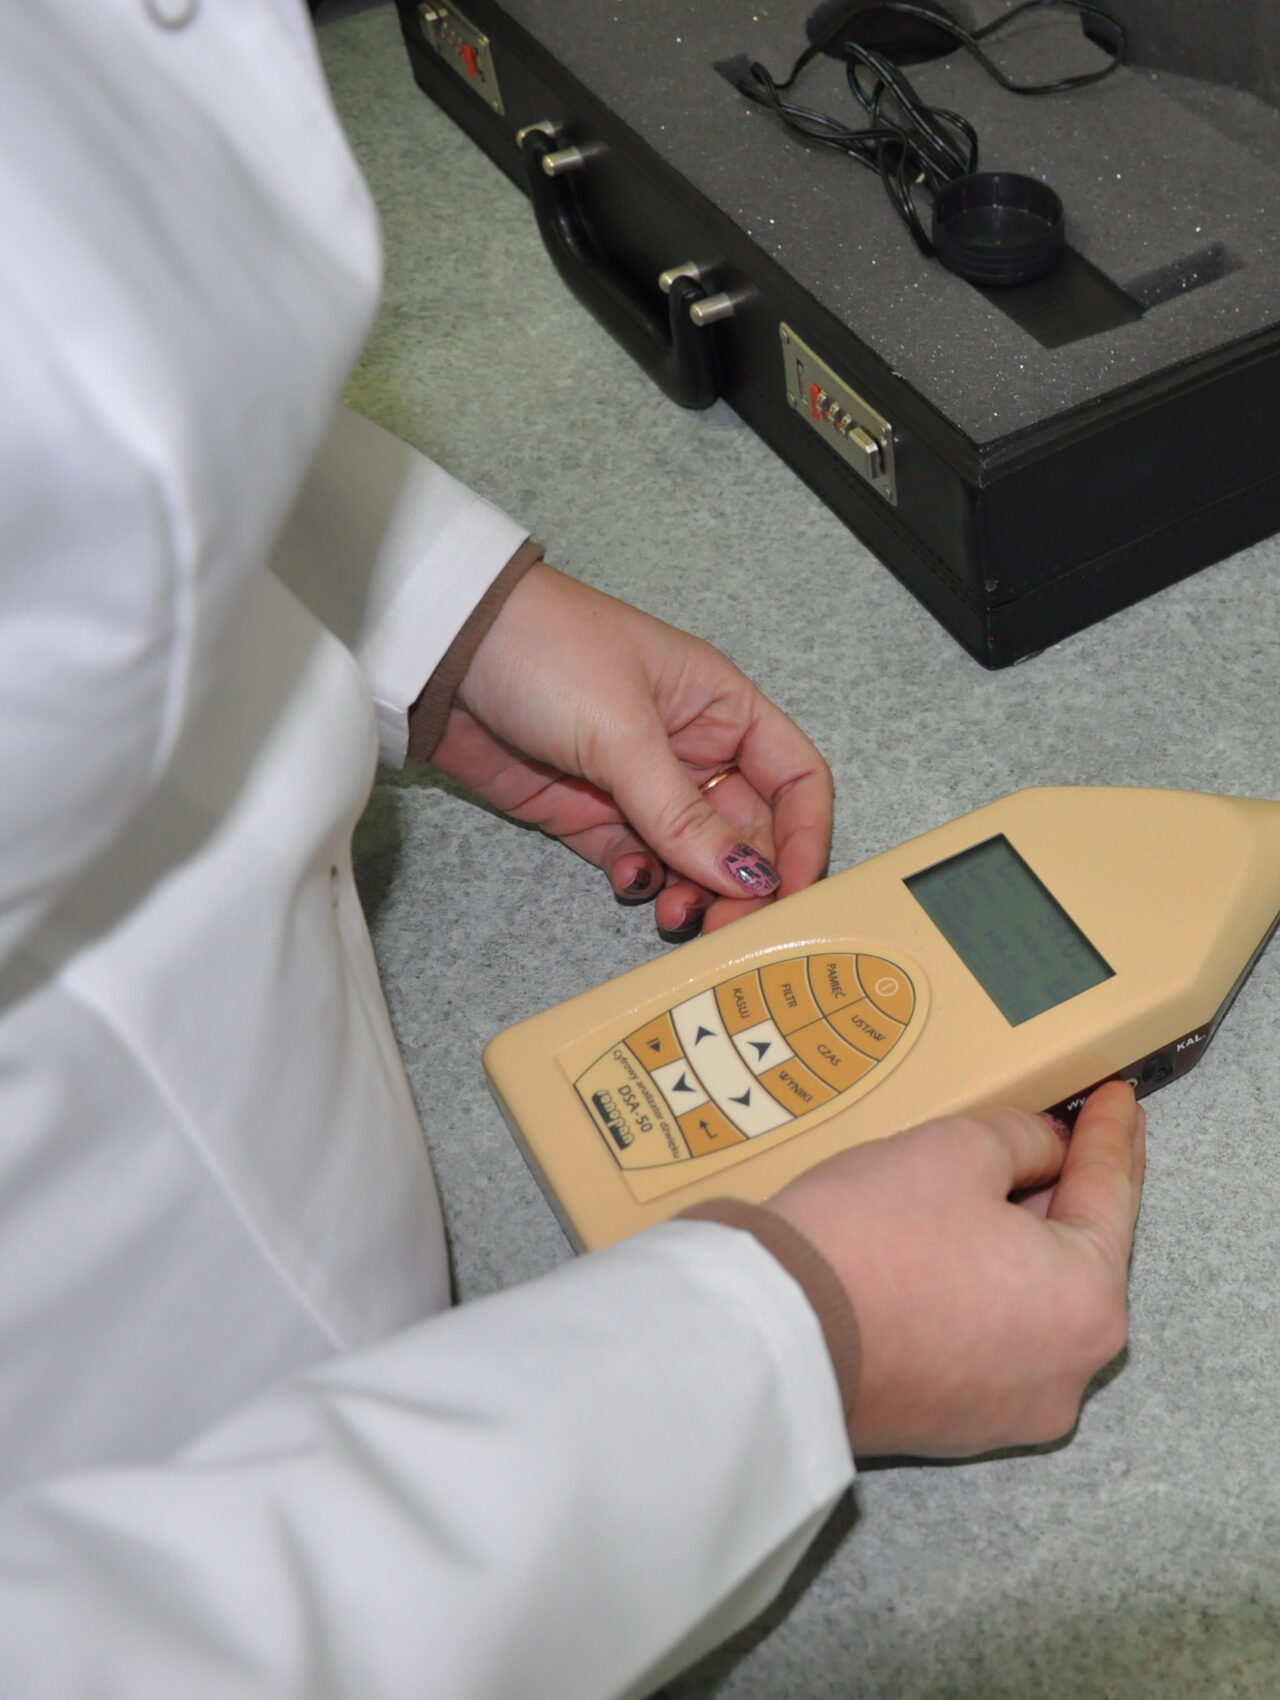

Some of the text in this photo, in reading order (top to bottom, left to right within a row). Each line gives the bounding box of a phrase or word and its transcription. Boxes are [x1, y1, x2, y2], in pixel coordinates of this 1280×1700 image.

[781, 983, 797, 1008] FILTR
[827, 963, 845, 999] PAMIĘĆ
[733, 987, 750, 1019] KASUJ
[851, 1015, 887, 1042] USTAW
[1176, 1033, 1206, 1053] KAL.
[817, 1043, 842, 1066] CZAS
[779, 1070, 813, 1103] WYNIKI
[613, 1049, 680, 1159] Cyfrowy analizator dźwięku
